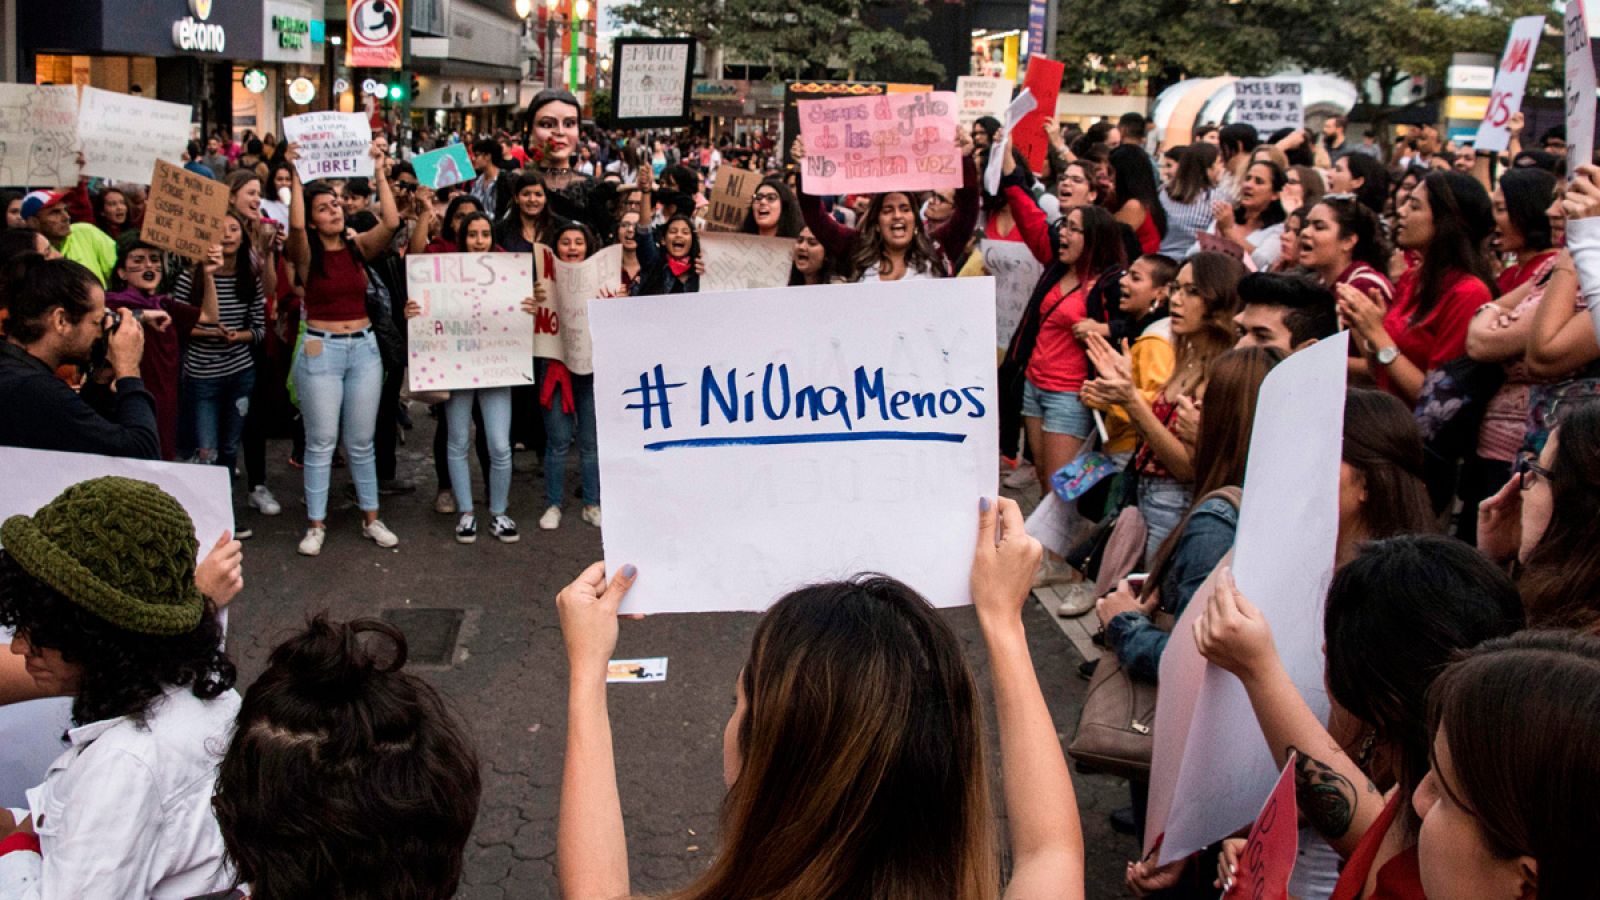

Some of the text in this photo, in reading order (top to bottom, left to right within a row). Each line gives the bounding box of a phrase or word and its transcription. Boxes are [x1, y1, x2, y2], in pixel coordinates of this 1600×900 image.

[896, 92, 949, 137] grito
[307, 158, 357, 175] LIBRE!
[408, 254, 496, 286] GIRLS
